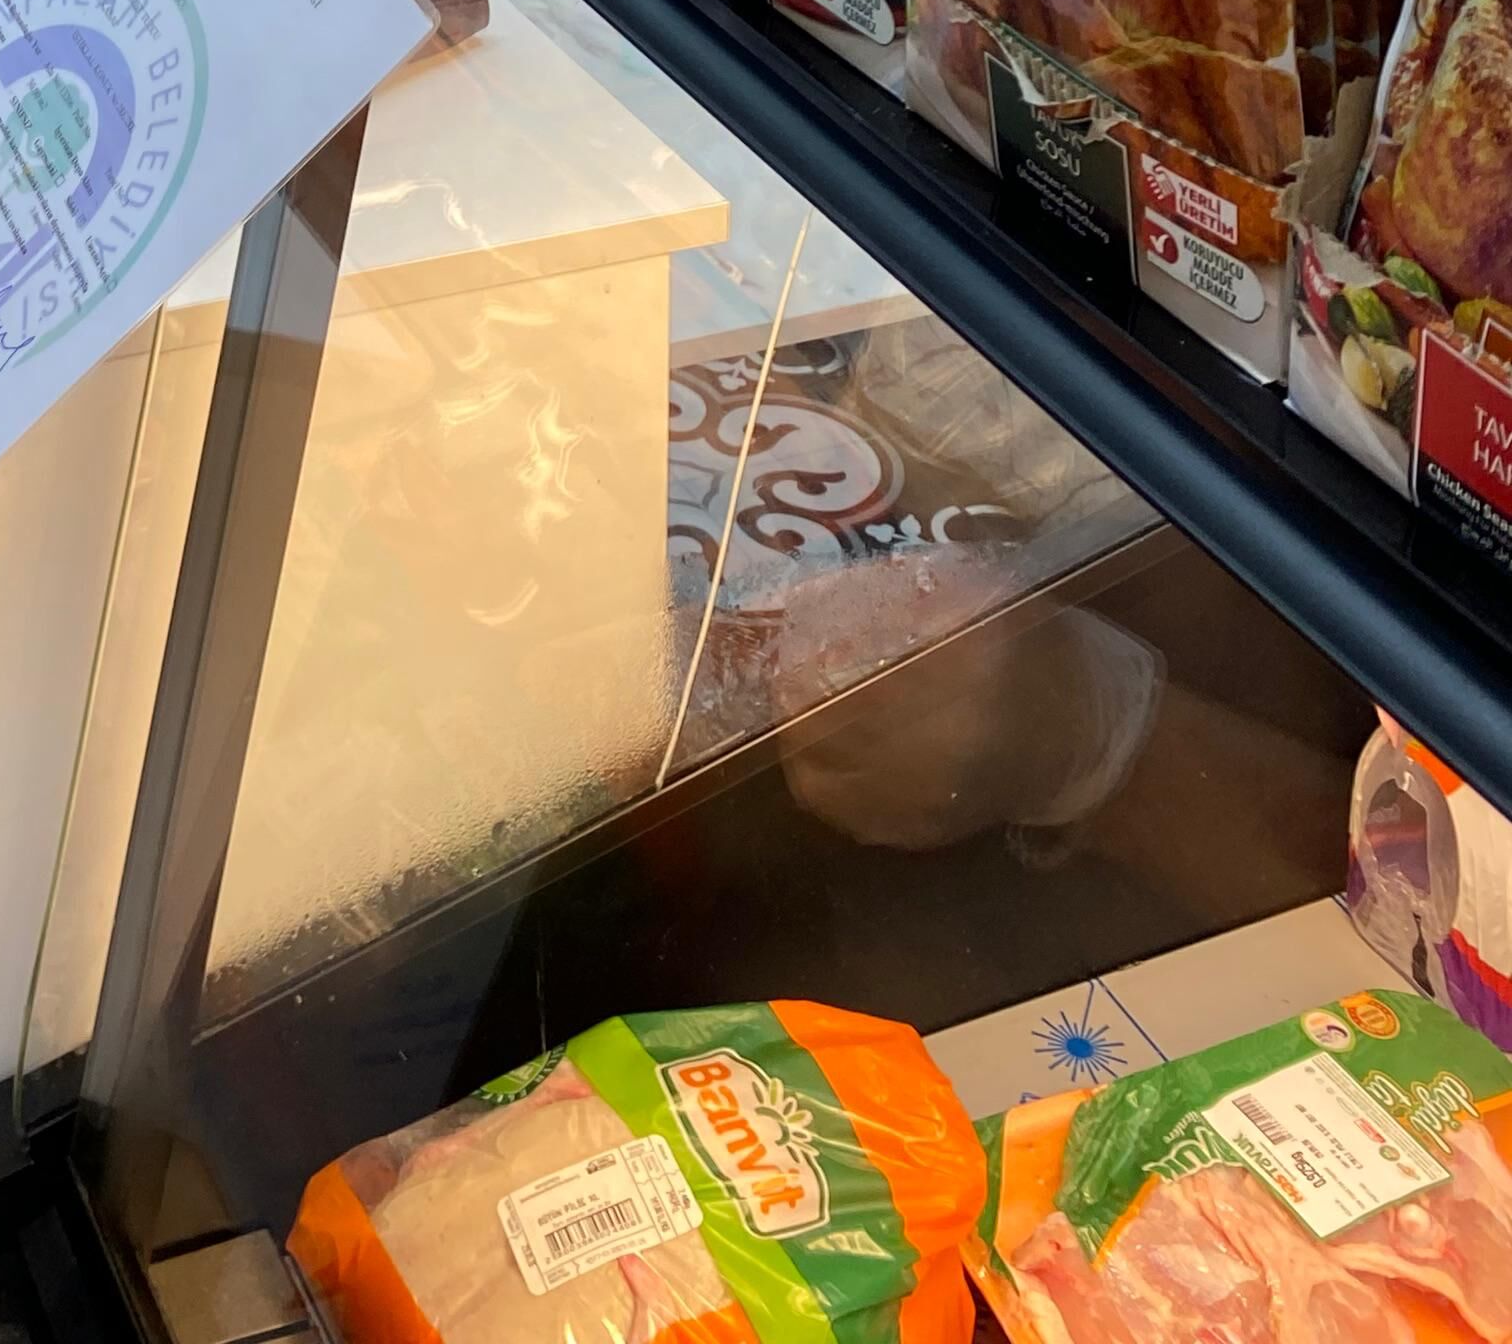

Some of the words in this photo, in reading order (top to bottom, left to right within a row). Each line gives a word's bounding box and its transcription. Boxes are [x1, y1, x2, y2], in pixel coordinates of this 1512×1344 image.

[1035, 131, 1081, 176] SOSU
[1179, 182, 1221, 216] YERLİ
[1179, 196, 1235, 241] ÜRETİM
[1183, 235, 1245, 281] KORUYUCU
[1193, 257, 1234, 291] MADDE
[1189, 269, 1239, 310] İÇERMEZ
[1427, 462, 1481, 514] Chicken
[677, 1060, 807, 1216] Banvit
